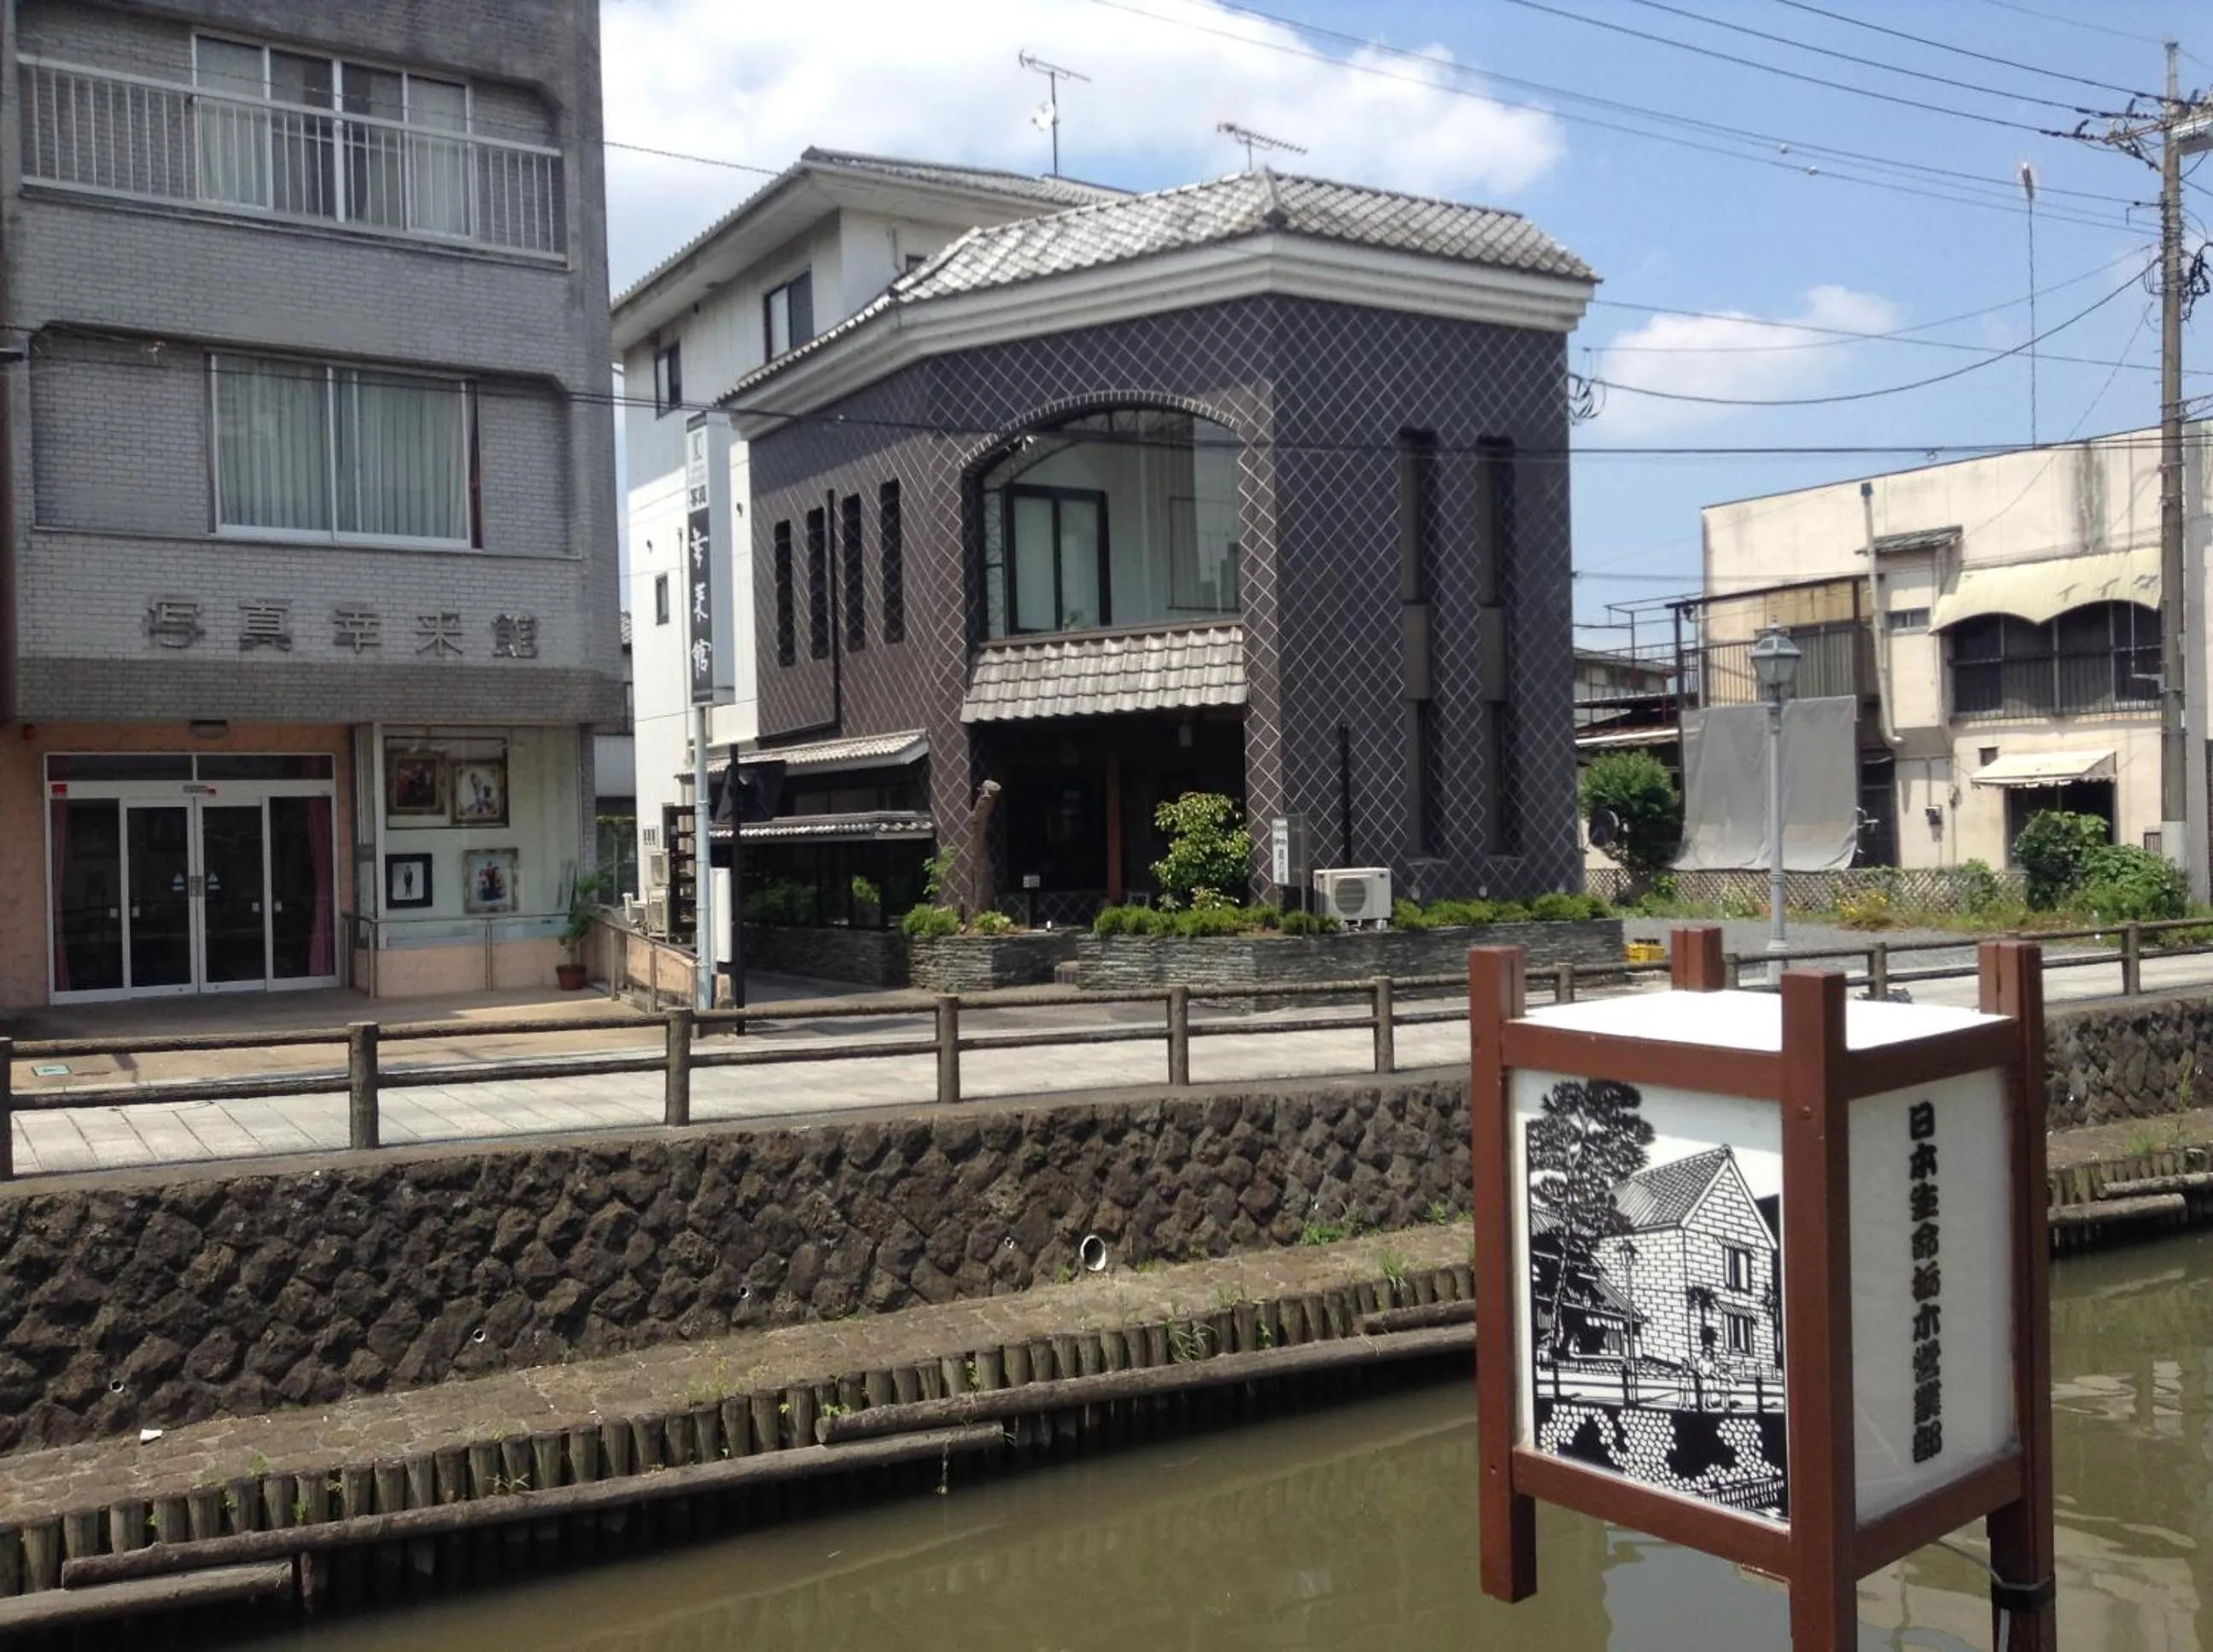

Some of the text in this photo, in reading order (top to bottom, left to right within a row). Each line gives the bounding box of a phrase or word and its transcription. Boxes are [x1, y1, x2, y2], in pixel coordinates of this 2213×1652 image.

[1909, 1100, 1942, 1464] 日本生命栃木営業部
